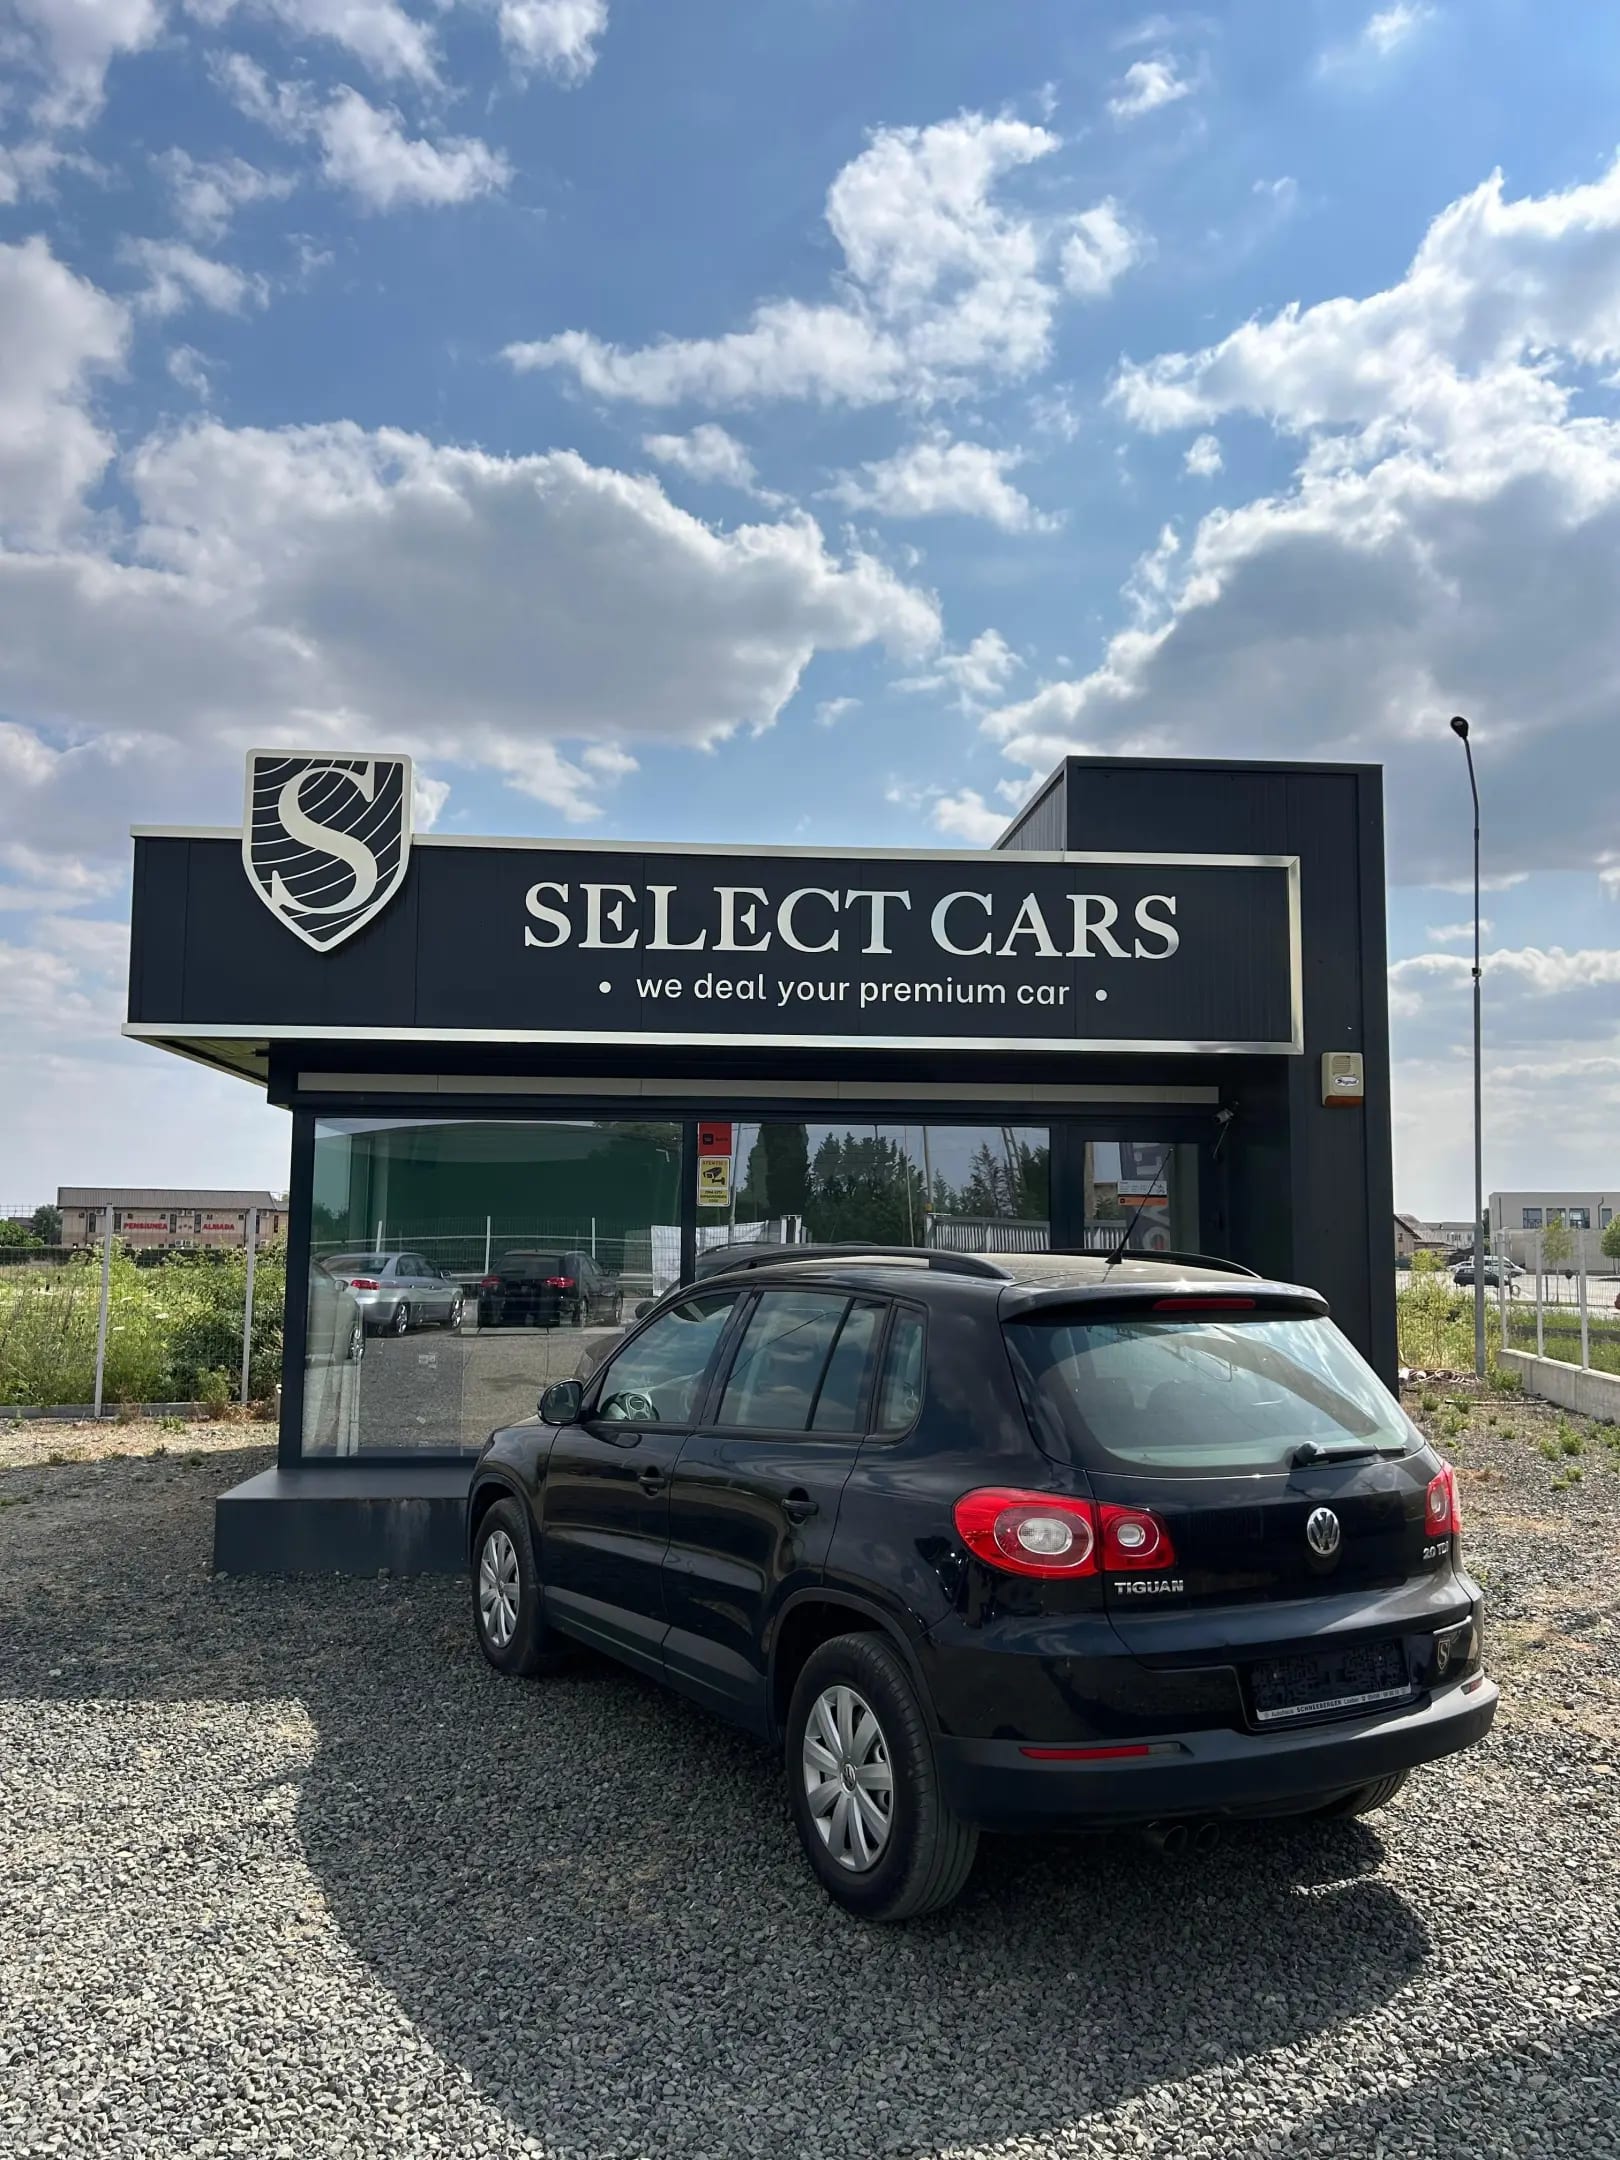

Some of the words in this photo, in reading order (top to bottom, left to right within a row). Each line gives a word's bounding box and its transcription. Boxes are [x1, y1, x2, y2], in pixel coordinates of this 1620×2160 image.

[271, 761, 378, 914] S
[524, 881, 912, 954] SELECT
[930, 891, 1180, 960] CARS
[636, 978, 683, 999] we
[693, 972, 767, 1000] deal
[777, 980, 850, 1007] your
[860, 976, 1006, 1009] premium
[1016, 985, 1070, 1005] car
[1113, 1579, 1184, 1595] TIGUAN
